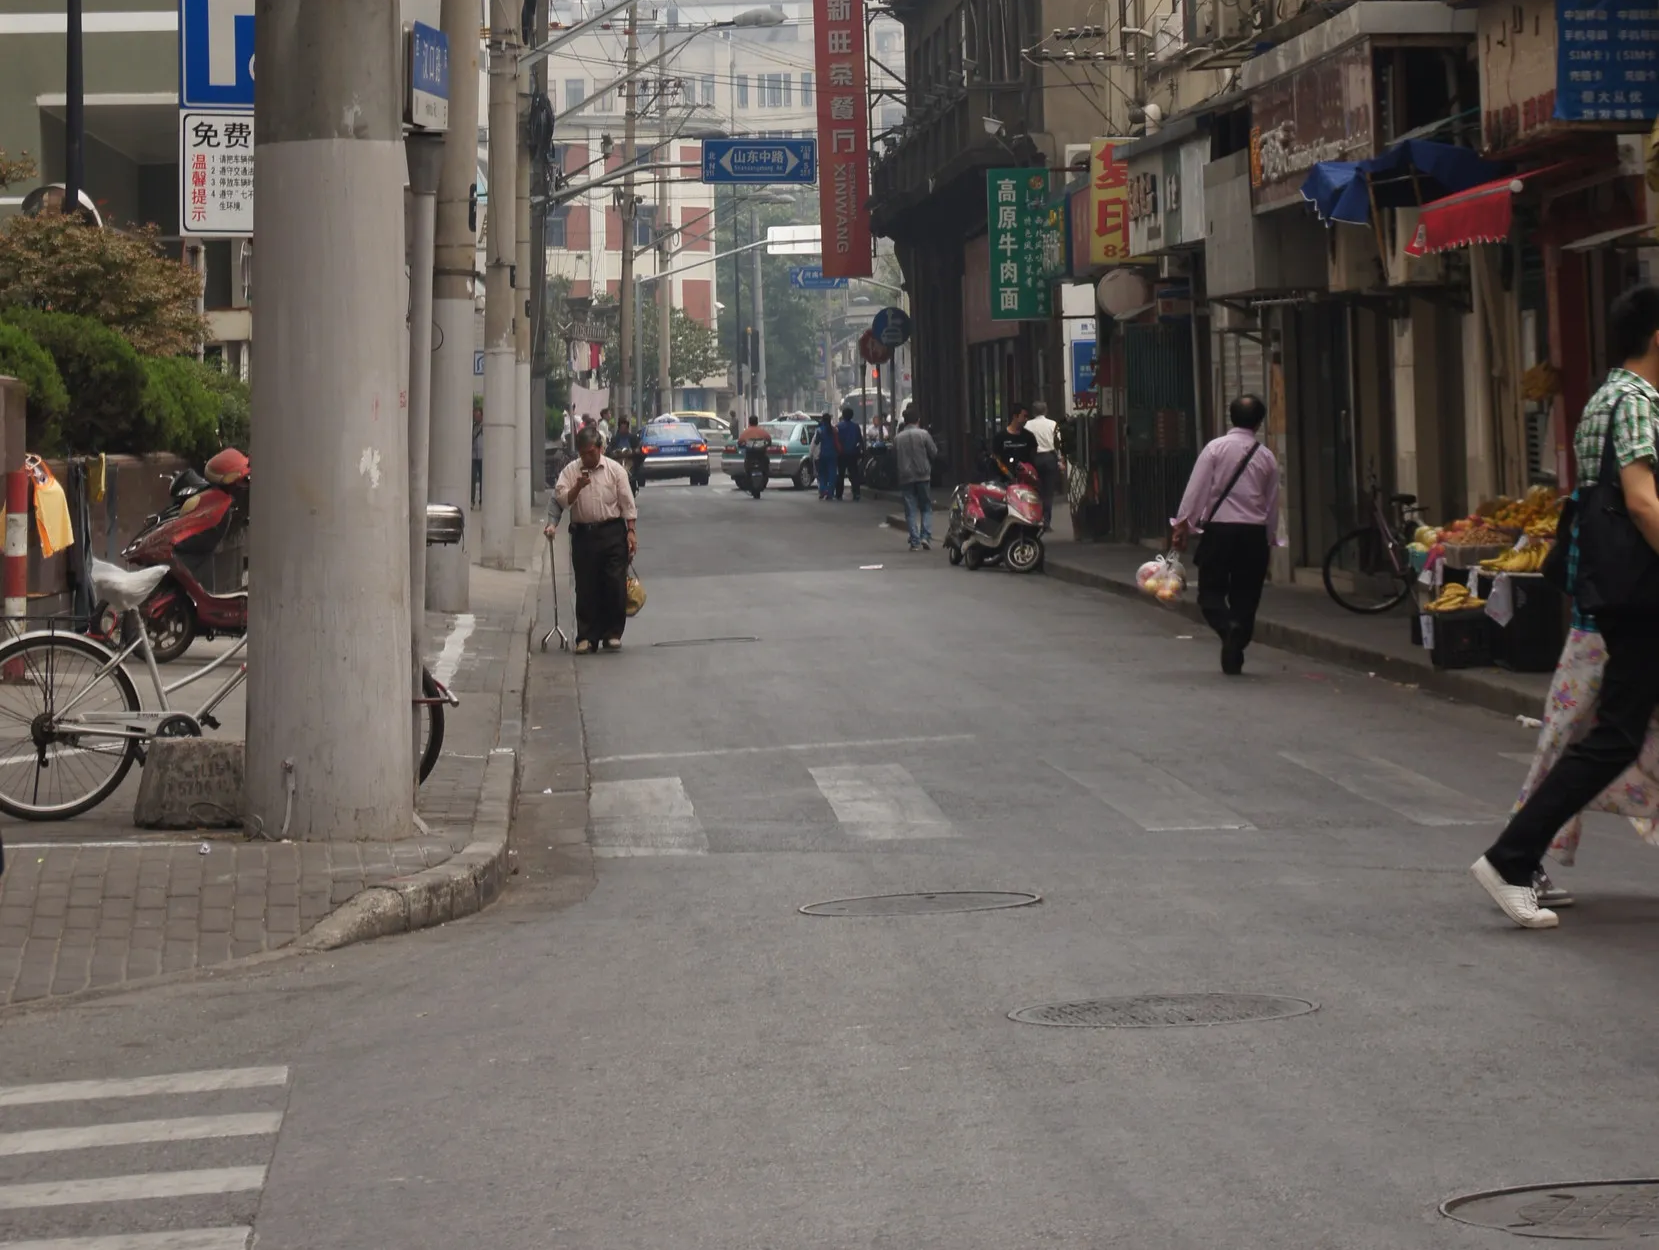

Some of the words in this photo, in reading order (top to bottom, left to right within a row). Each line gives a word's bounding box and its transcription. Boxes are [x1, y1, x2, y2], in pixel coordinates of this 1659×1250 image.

[192, 121, 251, 148] 免费
[734, 150, 784, 163] 山东中路
[192, 154, 207, 221] 温馨提示
[834, 163, 849, 254] XINWANG
[997, 179, 1019, 311] 高原牛肉面
